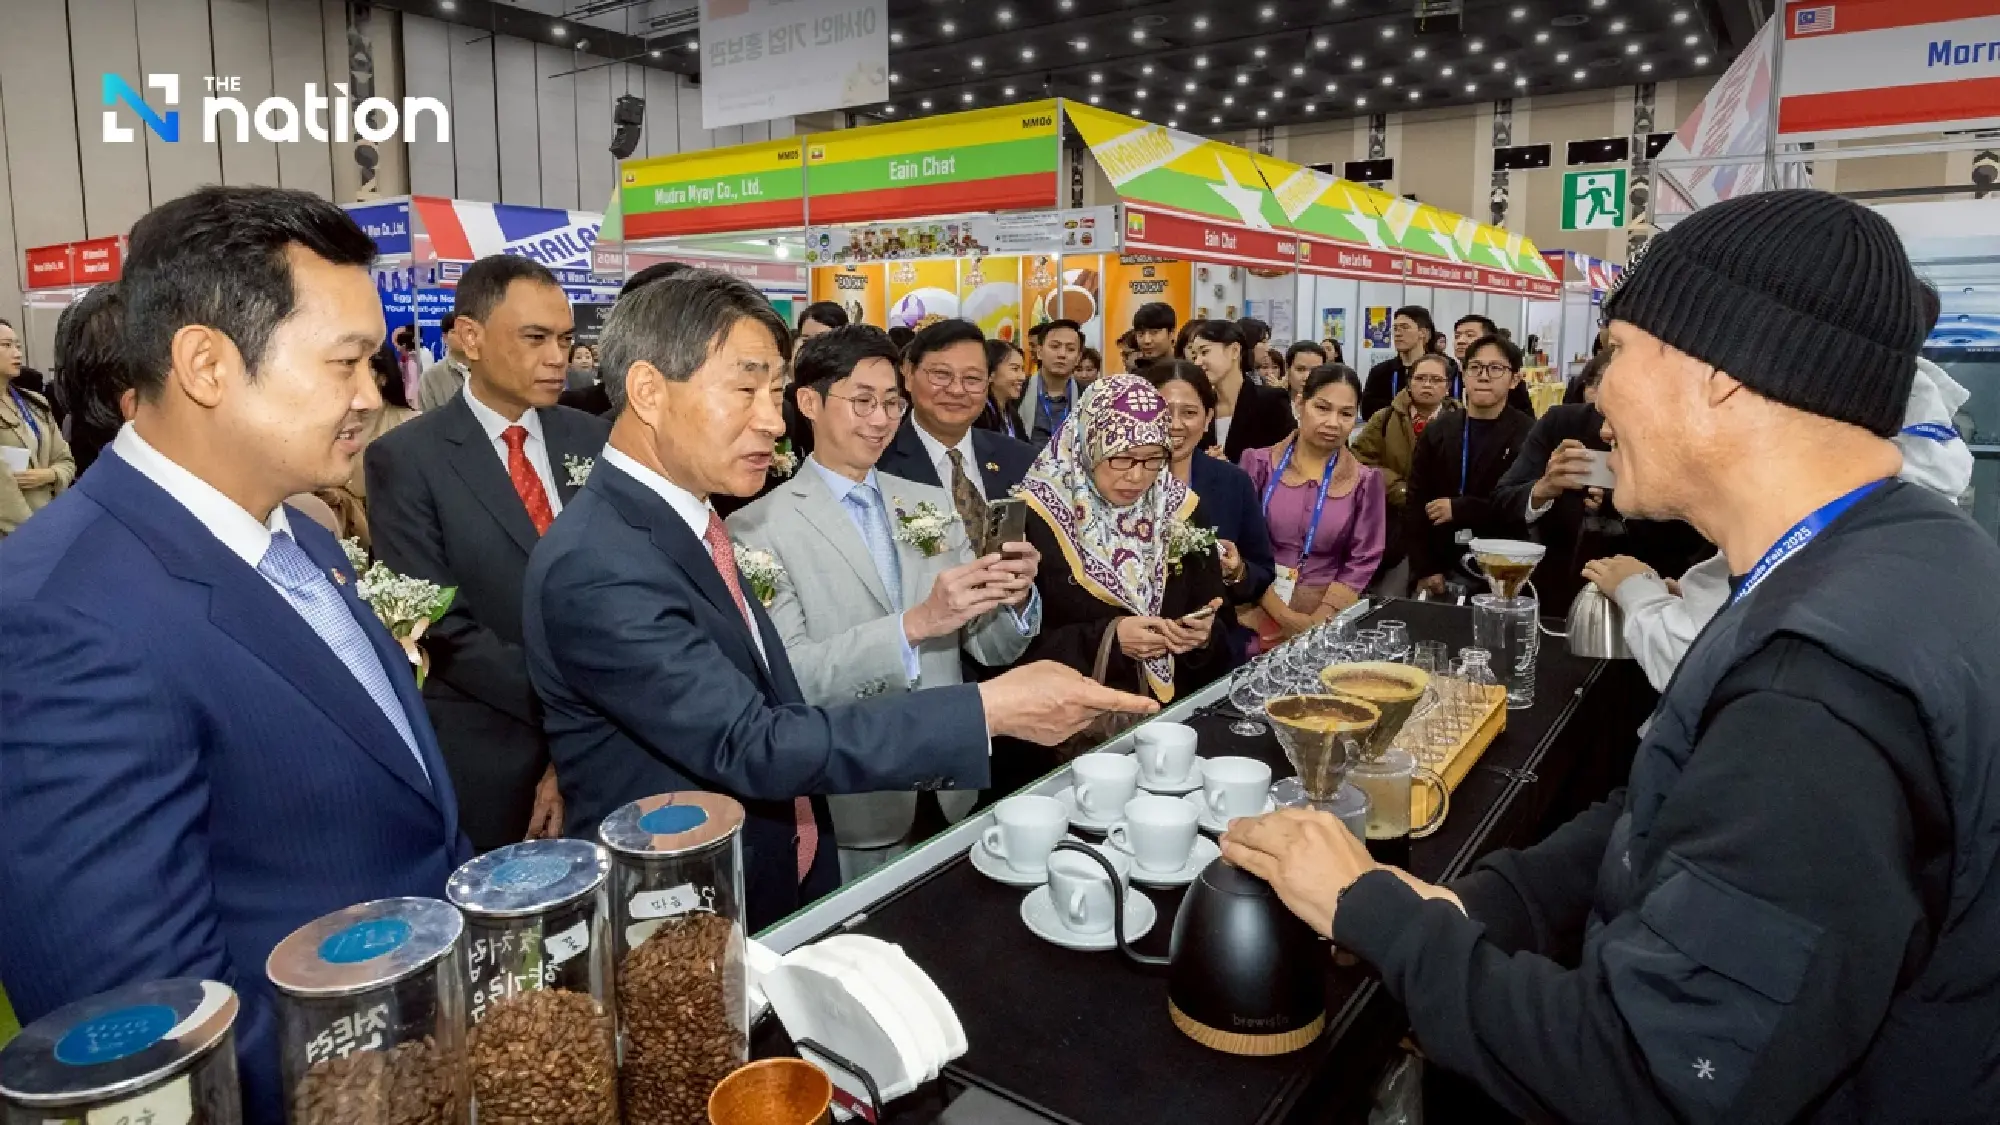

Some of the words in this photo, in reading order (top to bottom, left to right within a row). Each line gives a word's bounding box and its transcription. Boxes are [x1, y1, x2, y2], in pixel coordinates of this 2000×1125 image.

[1022, 115, 1052, 129] MM06
[889, 160, 917, 181] Eain
[922, 155, 956, 176] Chat
[654, 187, 686, 206] Mudra
[688, 184, 715, 203] Myay
[717, 181, 738, 200] Co.,
[741, 176, 764, 196] Ltd.
[1204, 228, 1220, 247] Eain
[1221, 231, 1237, 250] Chat
[1782, 525, 1812, 550] 2025
